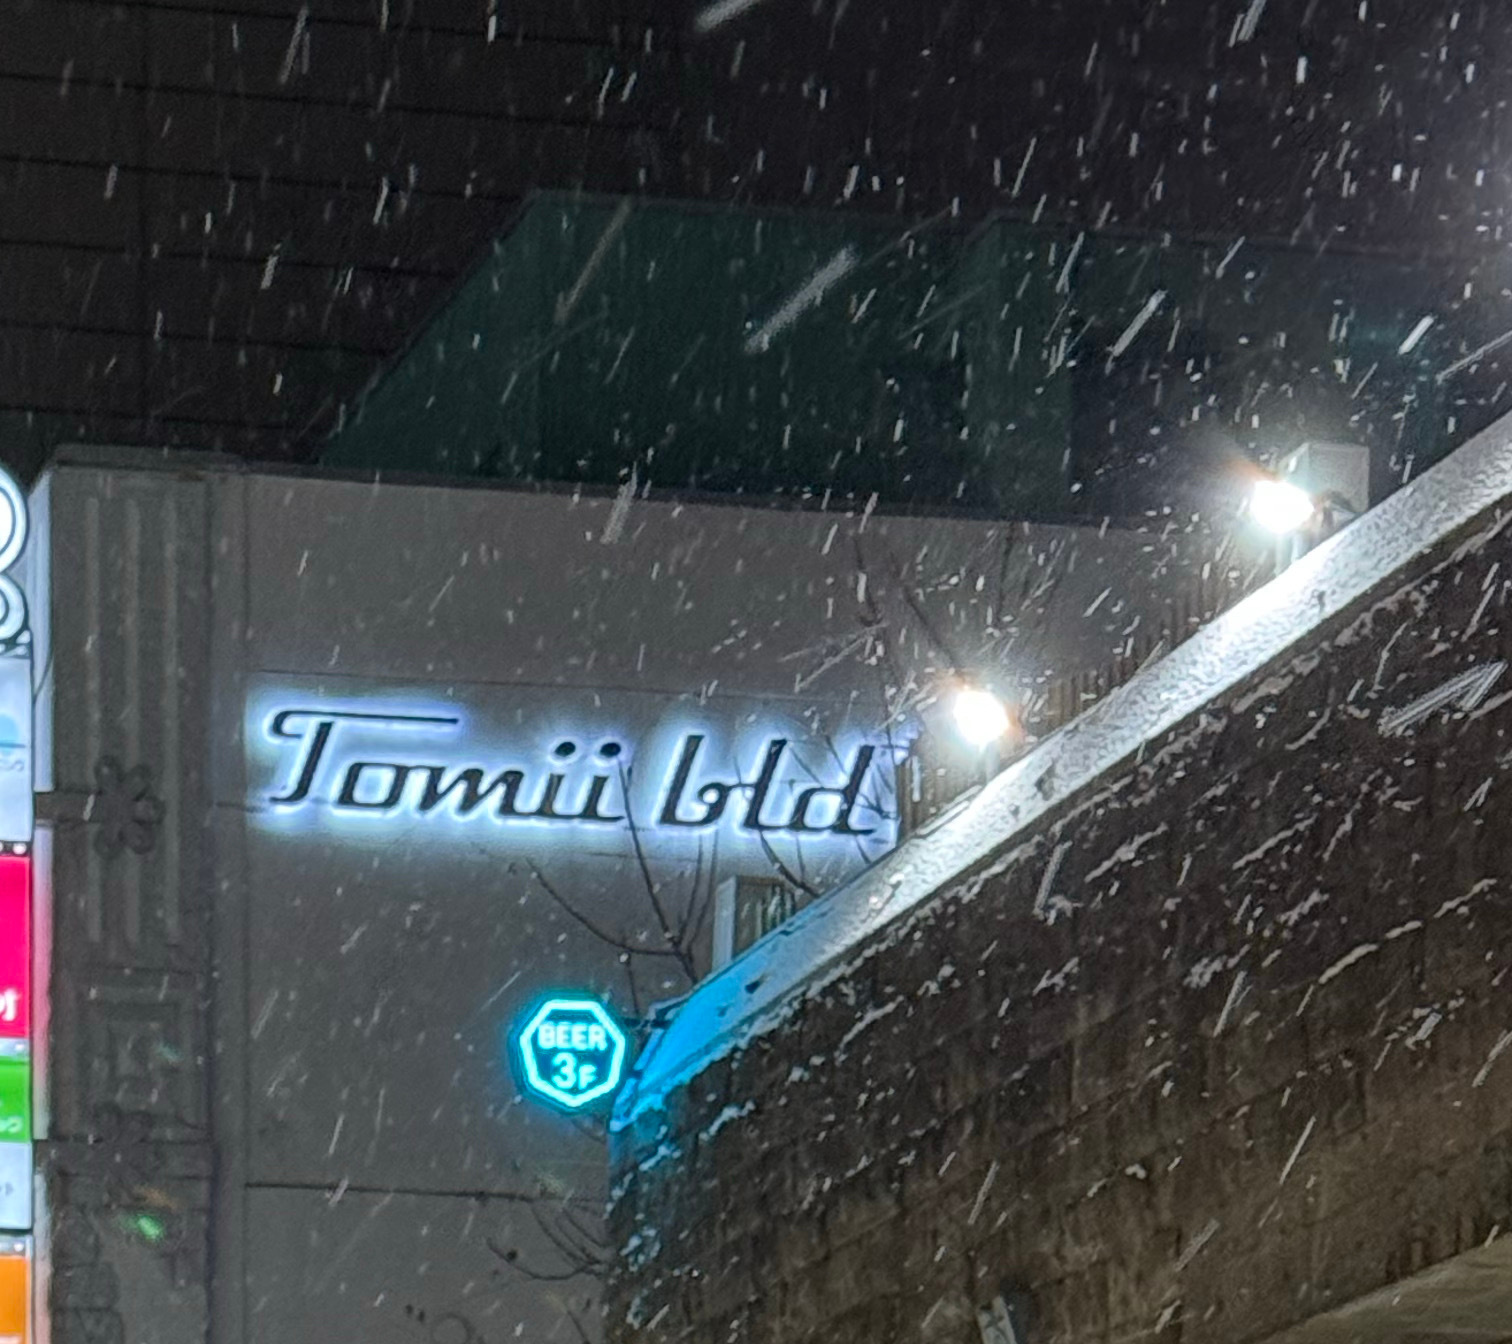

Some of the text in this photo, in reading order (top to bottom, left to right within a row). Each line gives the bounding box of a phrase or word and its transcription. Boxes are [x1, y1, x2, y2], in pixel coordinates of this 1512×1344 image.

[268, 709, 876, 836] Tomii bld
[537, 1020, 608, 1051] BEER
[551, 1051, 598, 1091] 3F
